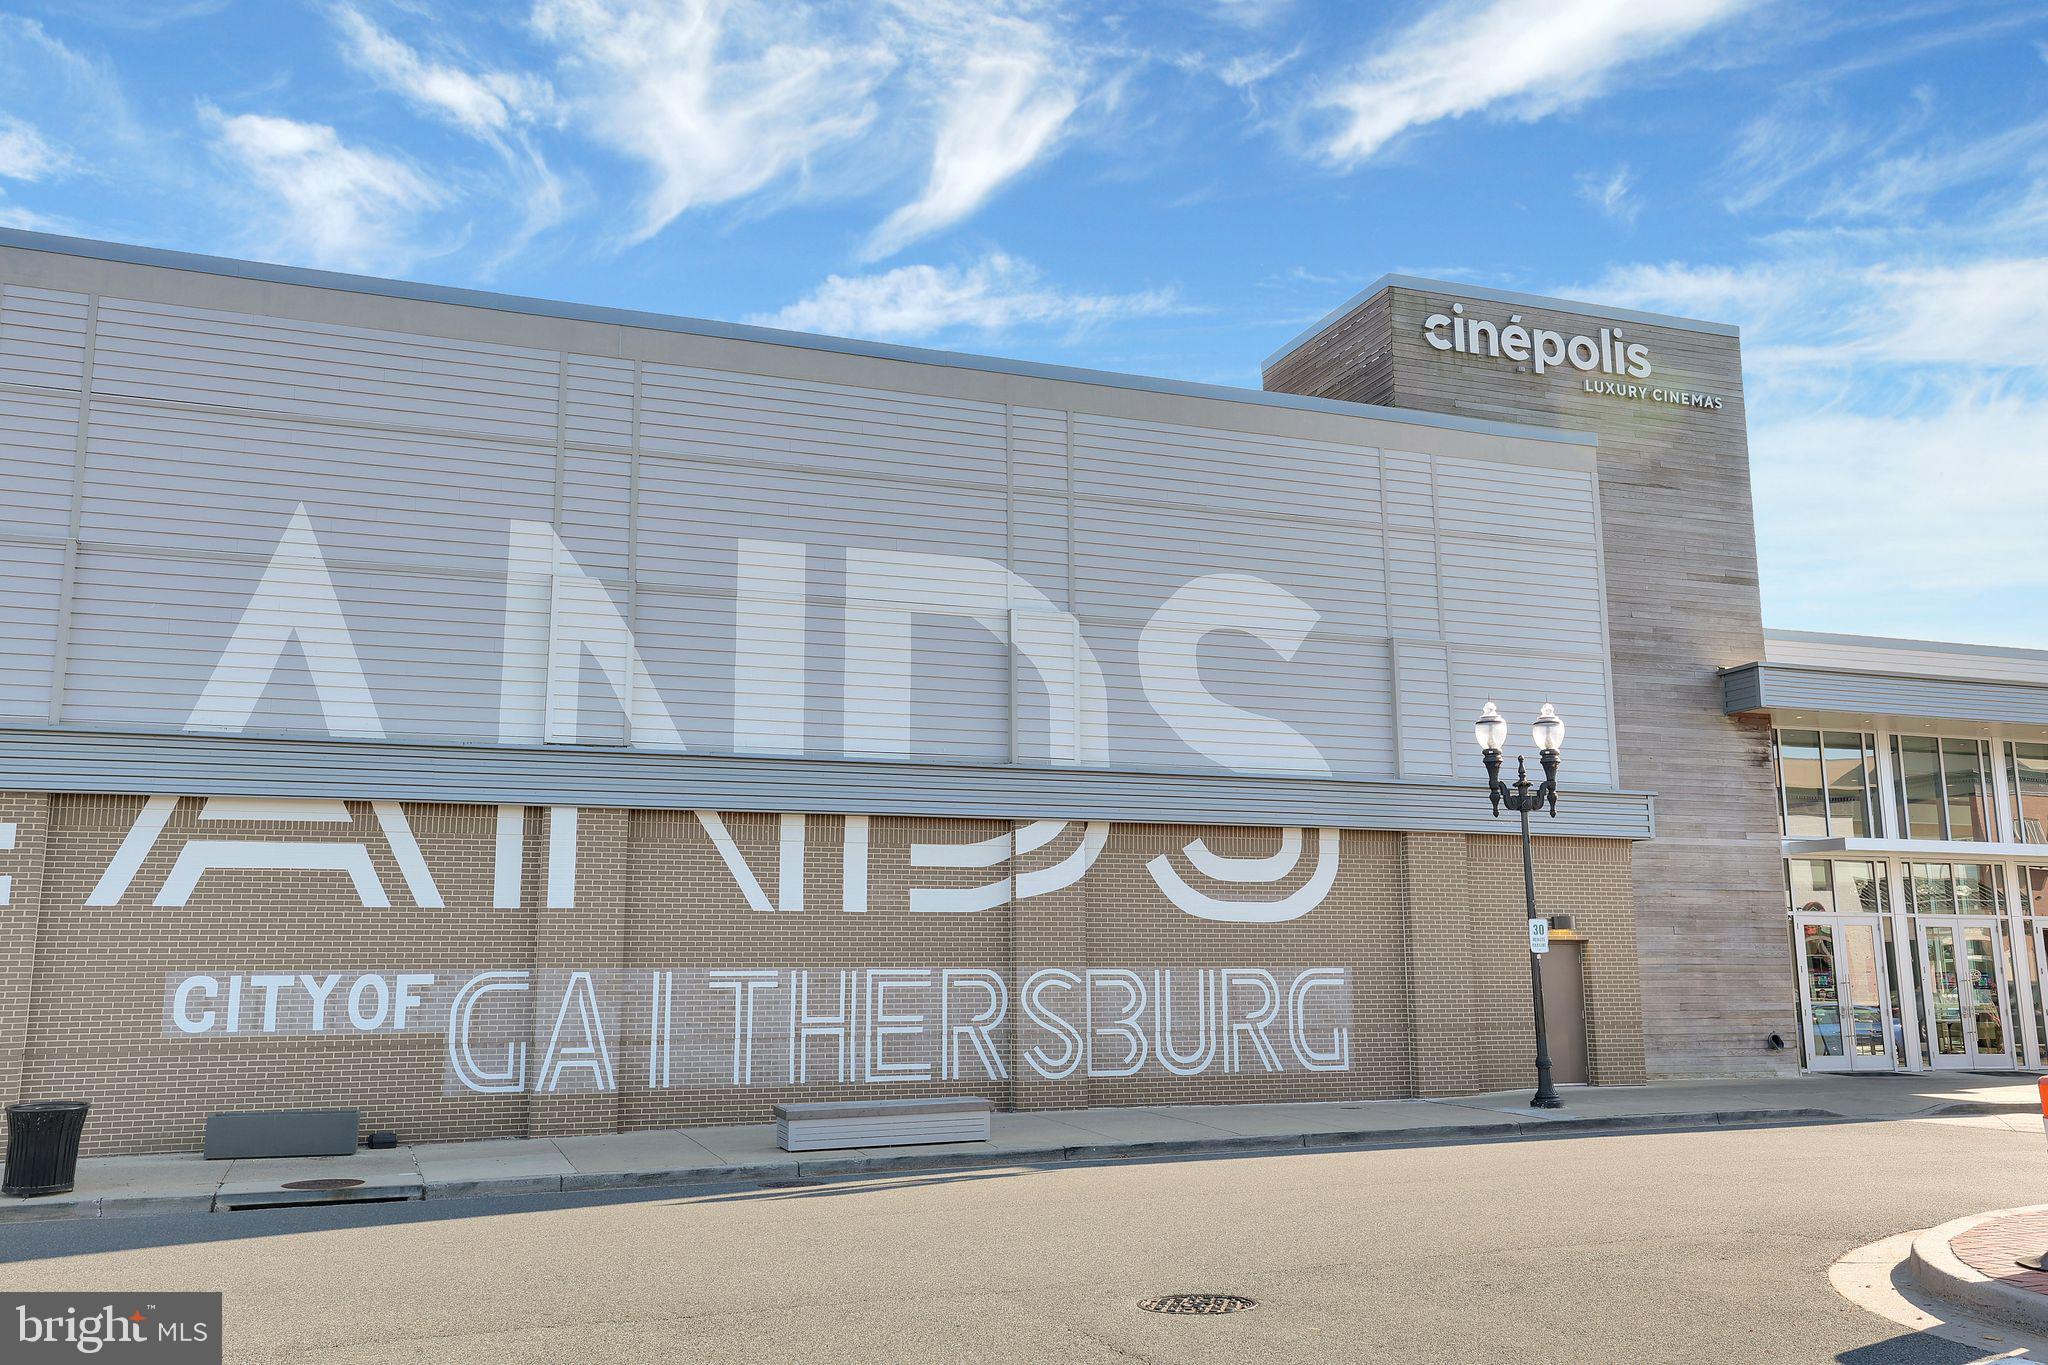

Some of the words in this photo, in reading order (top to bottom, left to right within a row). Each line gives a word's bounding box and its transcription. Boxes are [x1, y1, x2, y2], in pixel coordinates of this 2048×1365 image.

[1424, 303, 1651, 378] cinépolis
[1584, 380, 1647, 399] LUXURY
[1652, 389, 1723, 409] CINEMAS
[0, 503, 1342, 923] ANDS
[1533, 924, 1544, 935] 30
[173, 975, 341, 1033] CITY
[348, 974, 434, 1030] OF
[449, 967, 1350, 1093] GAITHERSBURG
